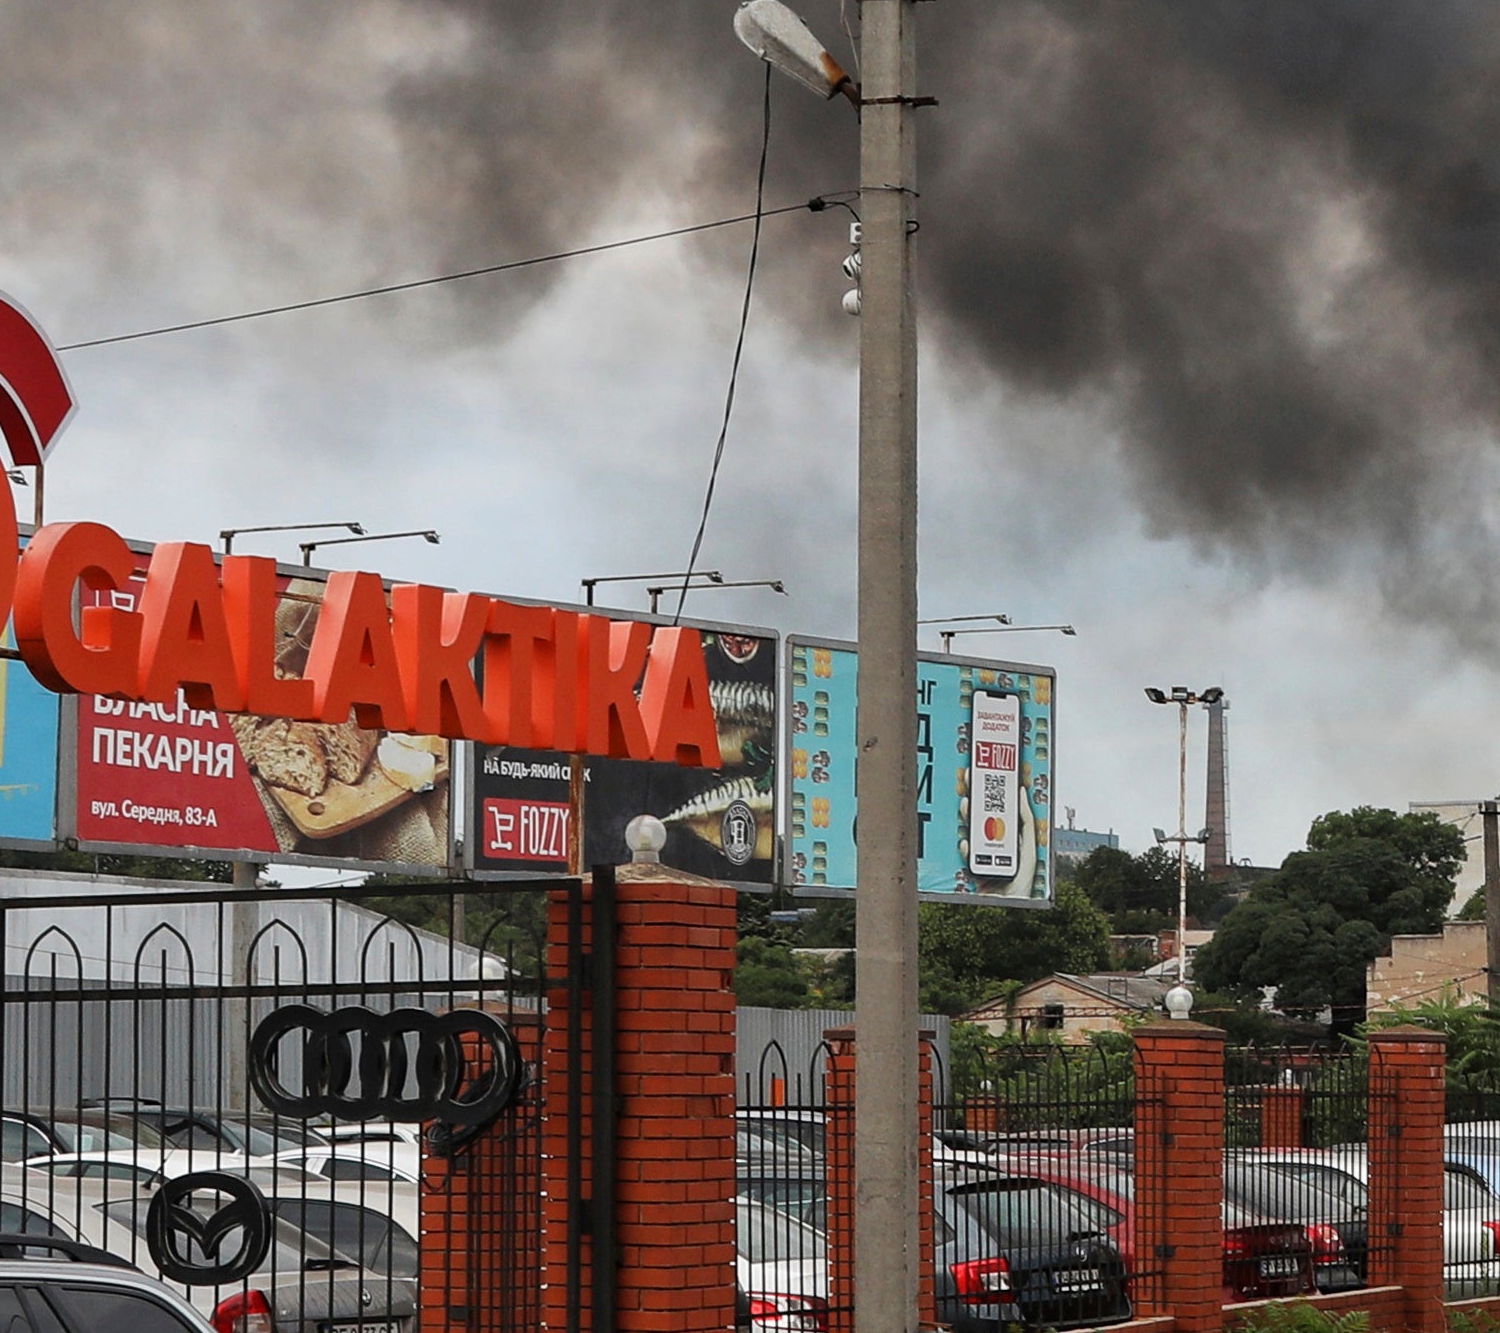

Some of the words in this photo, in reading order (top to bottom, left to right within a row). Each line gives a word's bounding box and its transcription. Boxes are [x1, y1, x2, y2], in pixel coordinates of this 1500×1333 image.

[92, 726, 235, 779] ПЕКАРНЯ
[500, 761, 561, 780] БУДЬ-ЯКИЙ
[91, 799, 119, 820] вул.
[121, 799, 183, 826] Середня,
[185, 806, 218, 827] 83-А
[520, 805, 570, 857] FOZZY
